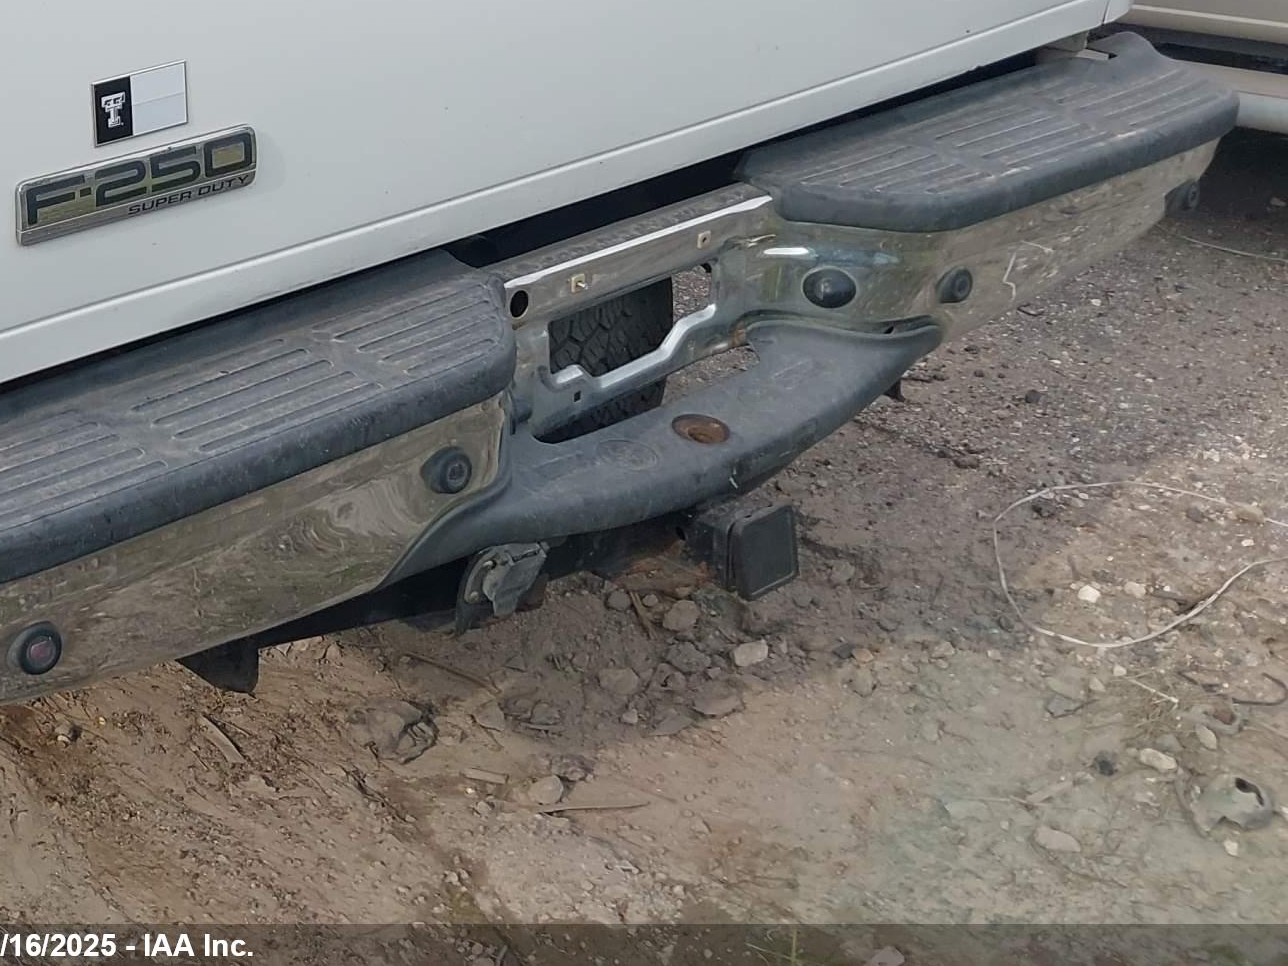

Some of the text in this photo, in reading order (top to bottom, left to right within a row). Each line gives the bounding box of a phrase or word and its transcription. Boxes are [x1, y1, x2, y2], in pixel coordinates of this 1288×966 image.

[26, 128, 253, 226] F-250
[128, 174, 250, 216] SUPER DUTY
